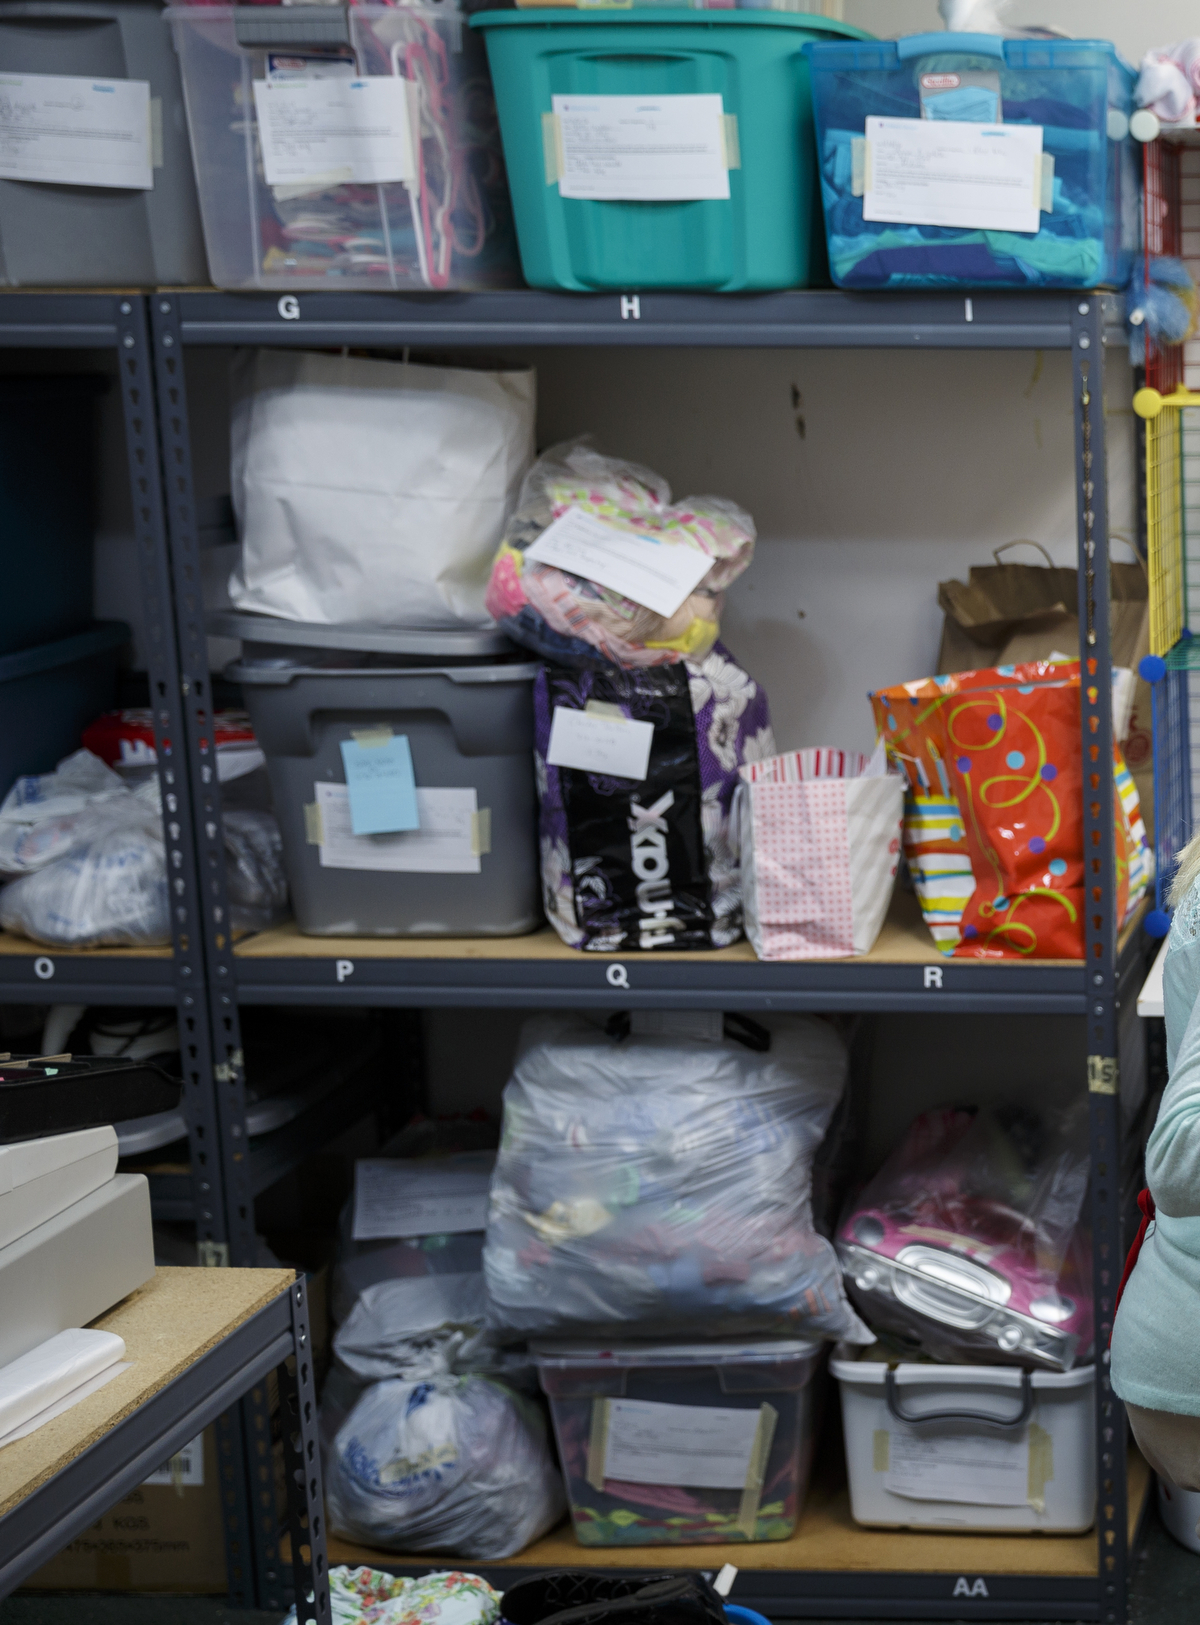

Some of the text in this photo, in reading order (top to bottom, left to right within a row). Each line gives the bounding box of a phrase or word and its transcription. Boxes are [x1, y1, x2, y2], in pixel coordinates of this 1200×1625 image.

[278, 295, 300, 320] G
[620, 296, 641, 320] H
[336, 960, 355, 983] P
[606, 963, 629, 989] Q
[924, 967, 943, 988] R
[953, 1576, 989, 1598] AA
